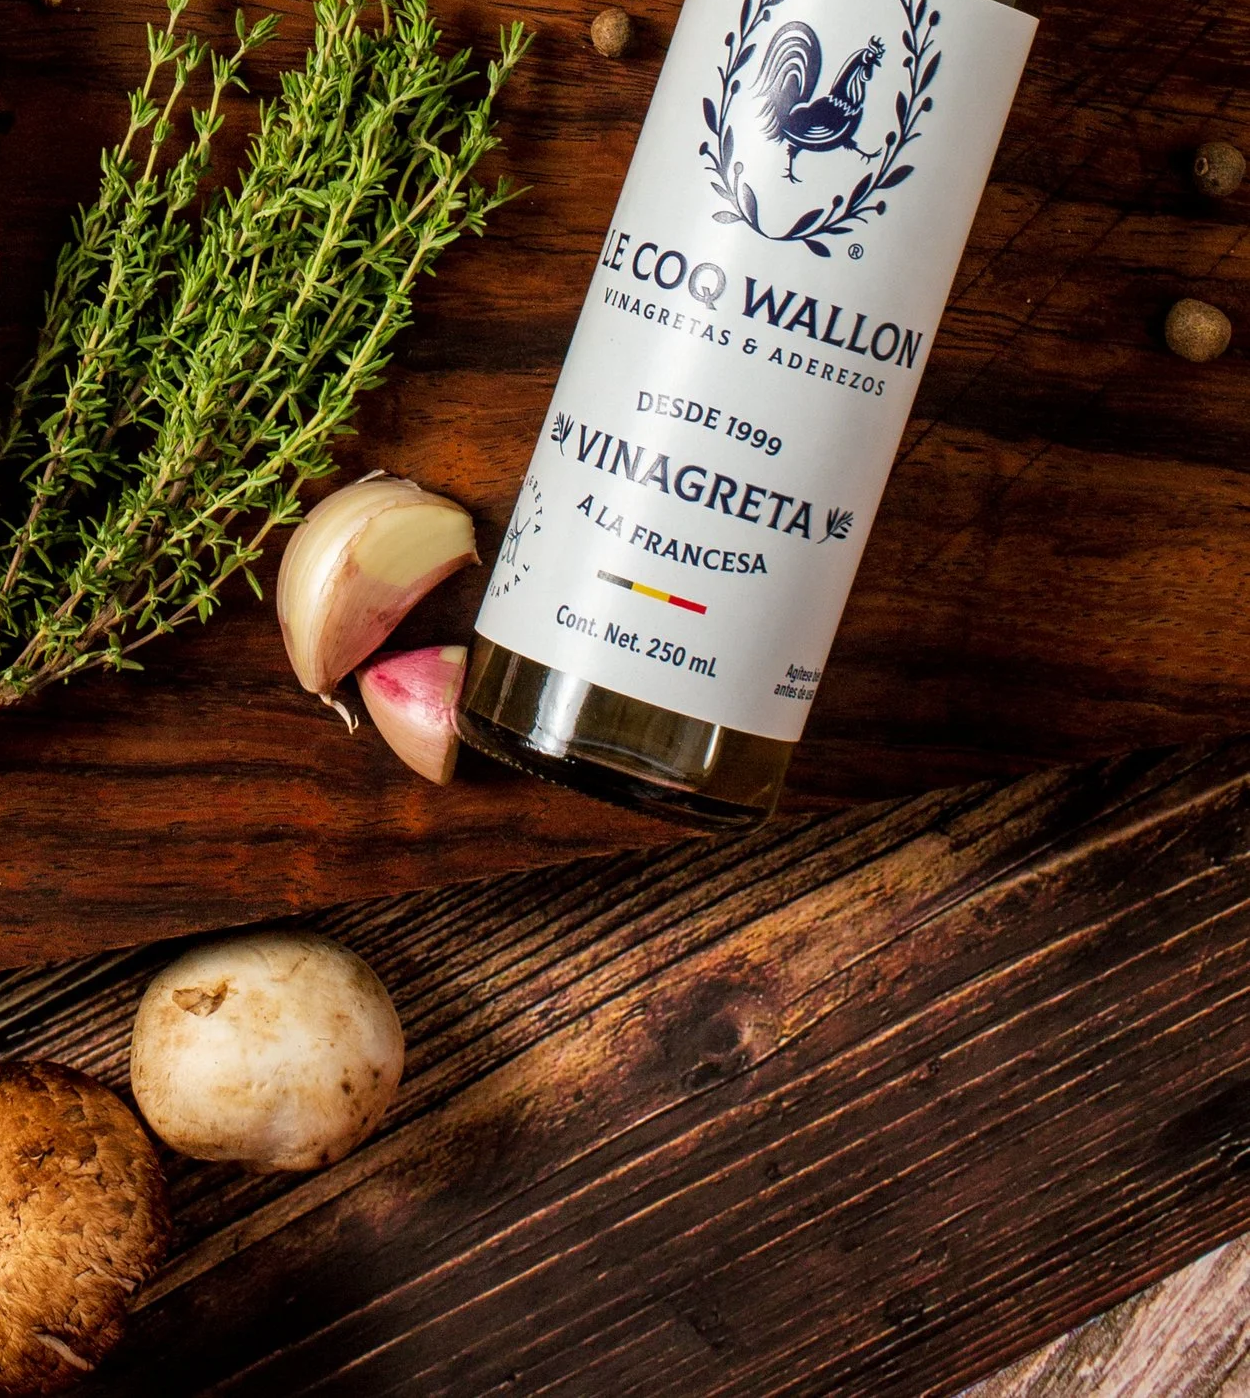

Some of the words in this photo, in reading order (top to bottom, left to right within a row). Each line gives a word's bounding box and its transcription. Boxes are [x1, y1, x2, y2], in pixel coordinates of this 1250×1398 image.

[602, 229, 631, 271] LE
[632, 242, 727, 311] COQ
[742, 276, 923, 369] WALLON
[604, 287, 731, 346] VINAGRETAS
[742, 338, 758, 355] &
[768, 347, 886, 397] ADEREZOS
[636, 391, 721, 430] DESDE
[725, 416, 783, 456] 1999
[576, 424, 813, 540] VINAGRETA
[577, 494, 595, 517] A
[595, 505, 623, 538] LA
[629, 524, 768, 574] FRANCESA
[556, 605, 598, 638] Cont.
[604, 622, 641, 653] Net.
[646, 638, 686, 667] 250
[688, 656, 717, 678] mL
[773, 684, 798, 699] antes
